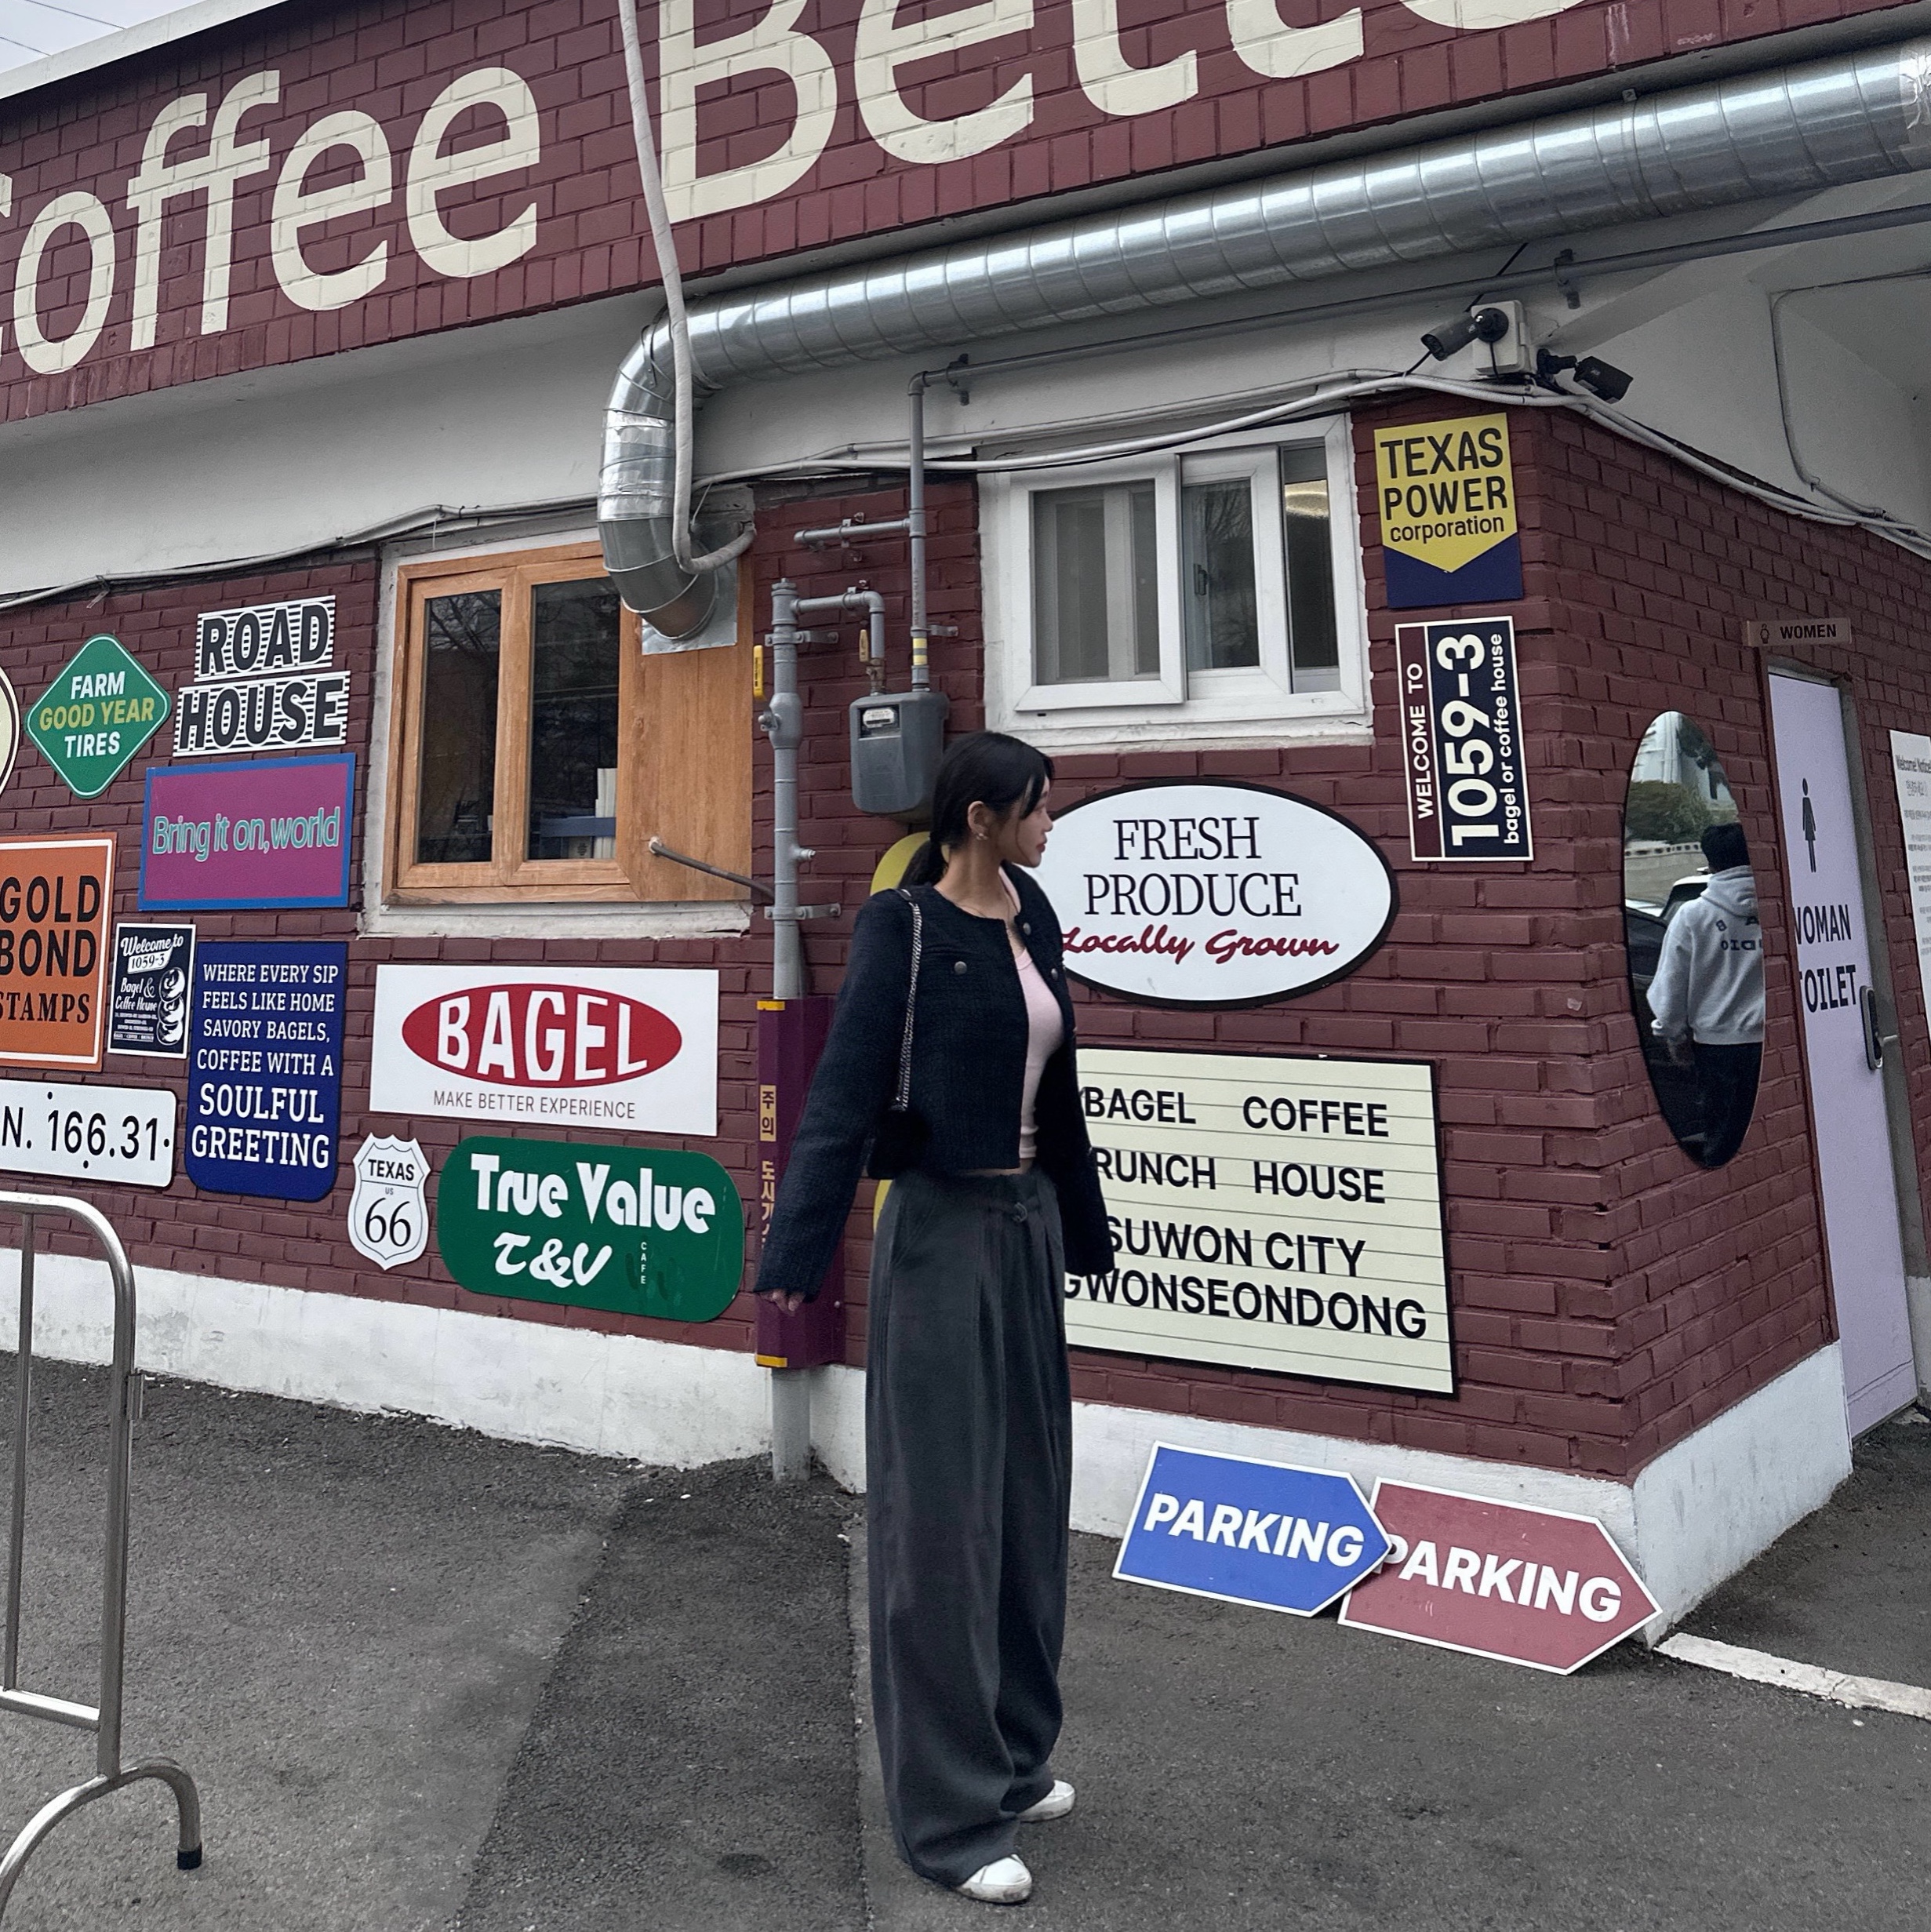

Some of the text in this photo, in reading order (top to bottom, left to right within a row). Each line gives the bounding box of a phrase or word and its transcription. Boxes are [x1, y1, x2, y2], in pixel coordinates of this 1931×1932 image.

[0, 67, 541, 375] offee
[1380, 428, 1504, 479] TEXAS
[1384, 475, 1508, 521] POWER
[1390, 515, 1505, 544] corporation
[199, 602, 331, 675] ROAD
[1780, 624, 1837, 639] WOMEN
[71, 671, 126, 700] FARM
[39, 697, 154, 731] GOOD YEAR
[179, 679, 344, 749] HOUSE
[64, 733, 121, 758] TIRES
[1407, 662, 1435, 820] WELCOME TO
[1436, 633, 1500, 846] 1059-3
[1491, 633, 1522, 844] bagel or coffee house
[153, 815, 211, 862] Bring
[214, 813, 231, 853] it
[1112, 817, 1262, 860] FRESH
[0, 875, 100, 923] GOLD
[1083, 873, 1303, 918] PRODUCE
[0, 929, 97, 977] BOND
[120, 933, 184, 957] Welcome to
[132, 953, 165, 970] 1059-3
[1062, 924, 1340, 965] Locally Grown
[121, 977, 156, 999] Bagel &
[202, 964, 339, 984] WHERE EVERY SIP
[1799, 964, 1856, 1013] OILET
[0, 991, 90, 1024] TAMPS
[202, 991, 336, 1012] FEELS LIKE HOME
[203, 1018, 330, 1043] SAVORY BAGELS,
[437, 991, 648, 1082] BAGEL
[197, 1048, 334, 1076] COFFEE WITH A
[199, 1082, 325, 1123] SOULFUL
[434, 1090, 636, 1119] MAKE BETTER EXPERIENCE
[1085, 1086, 1389, 1137] BAGEL COFFEE
[2, 1106, 158, 1161] N. 166.31
[191, 1124, 330, 1169] GREETING
[368, 1159, 415, 1181] TEXAS
[384, 1187, 394, 1195] US
[1096, 1147, 1386, 1204] RUNCH HOUSE
[471, 1152, 716, 1234] True Value
[365, 1197, 411, 1247] 66
[1265, 1232, 1366, 1277] CITY
[1143, 1493, 1365, 1567] PARKING
[1372, 1534, 1622, 1623] PARKING
